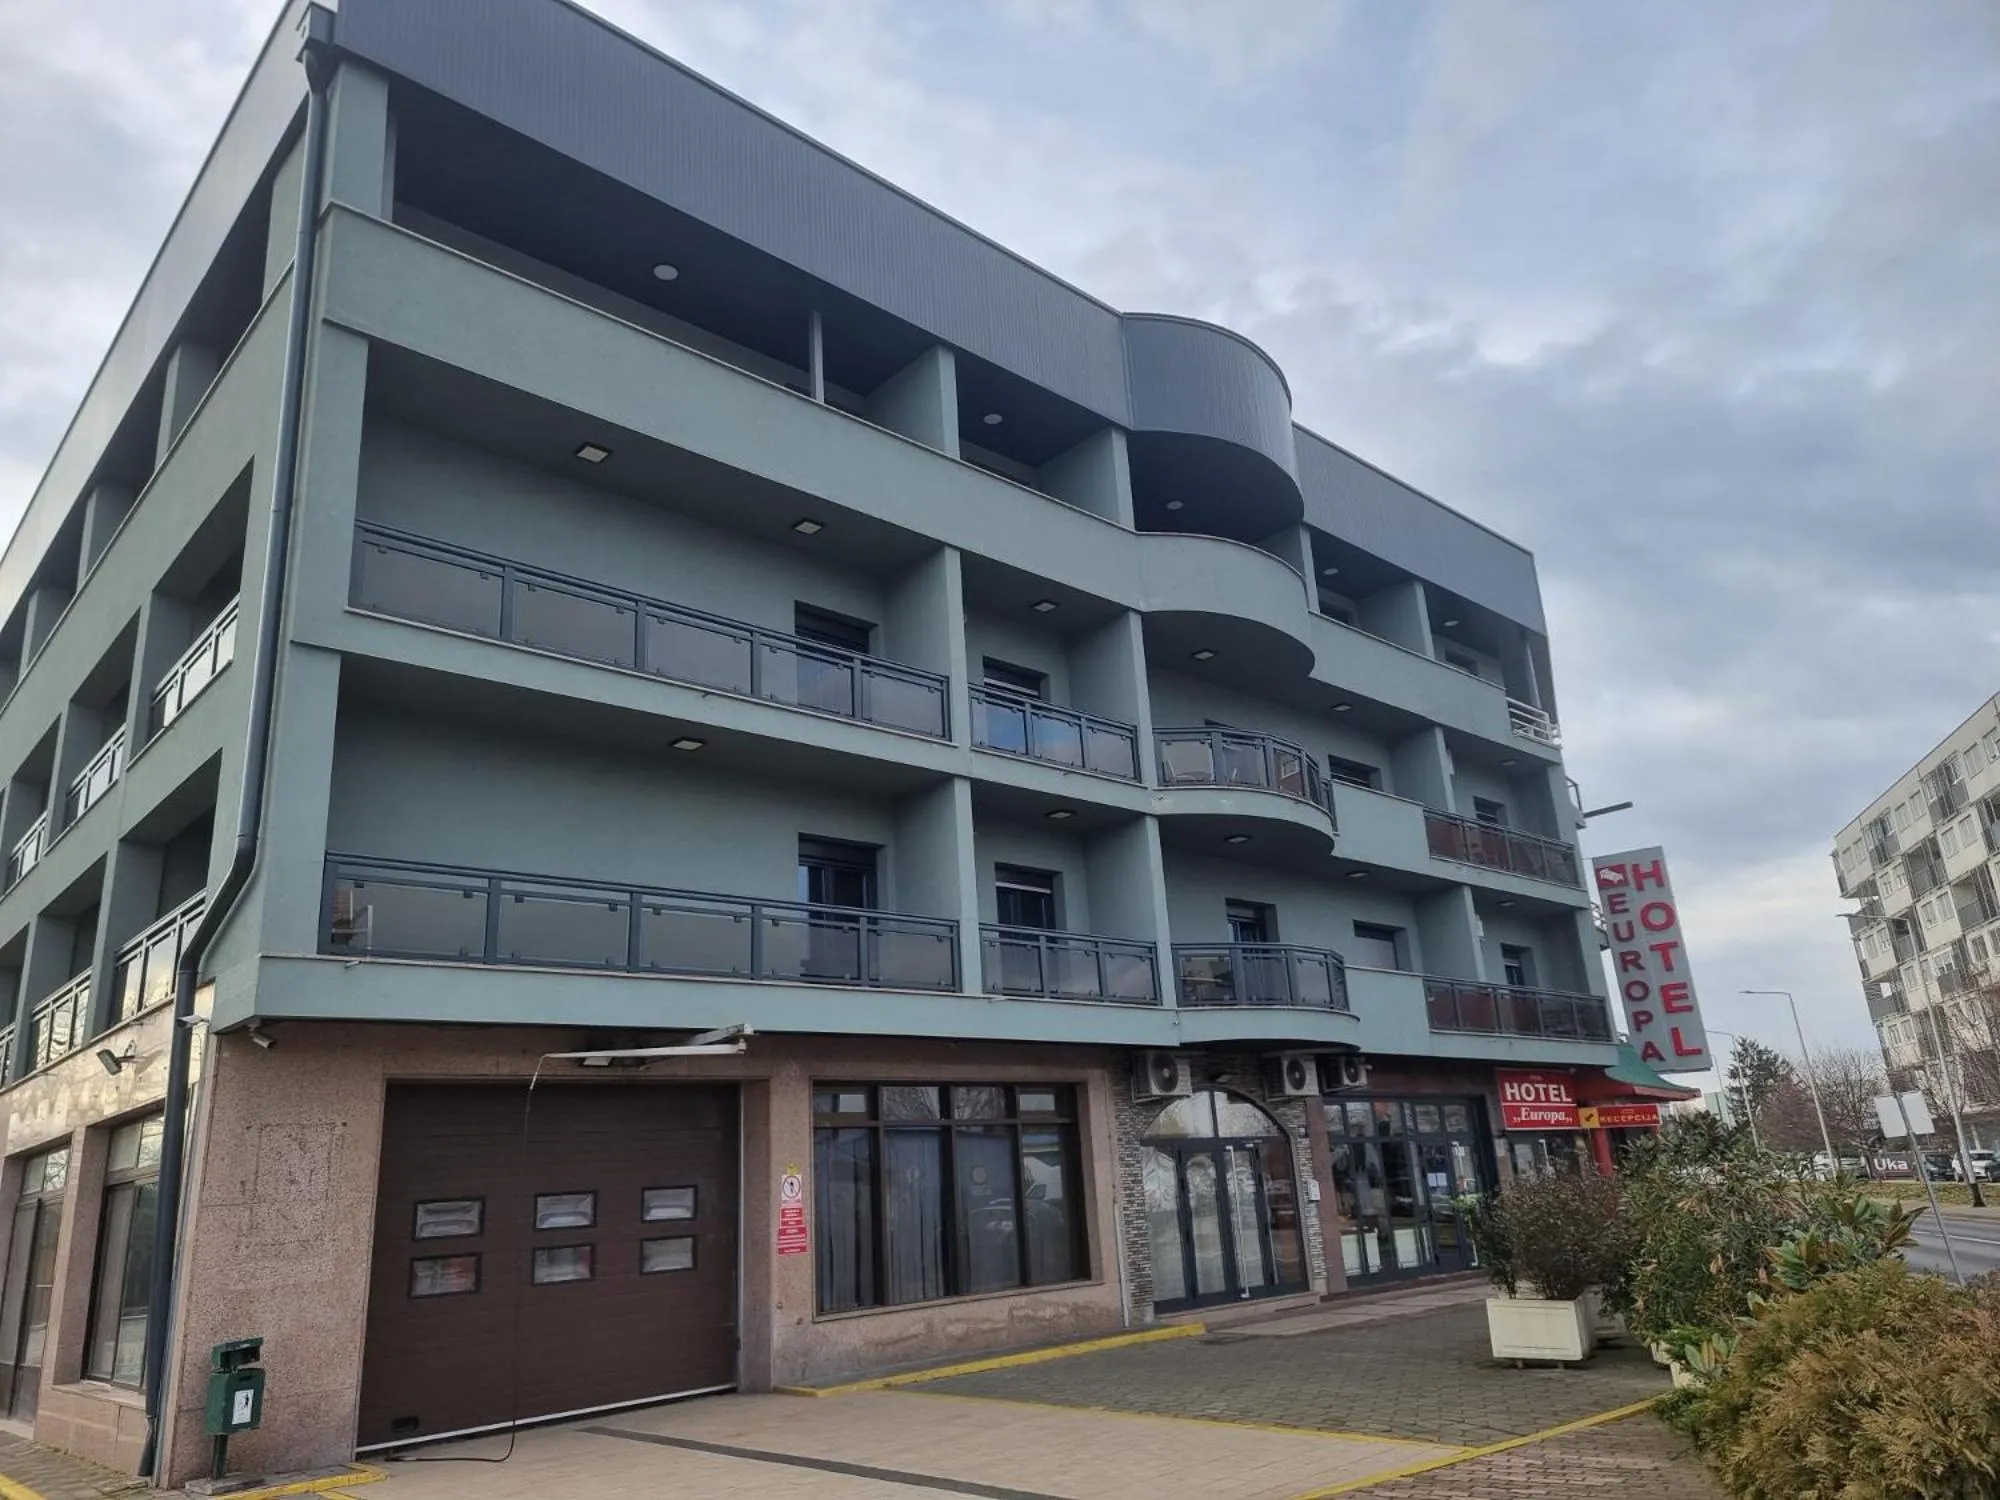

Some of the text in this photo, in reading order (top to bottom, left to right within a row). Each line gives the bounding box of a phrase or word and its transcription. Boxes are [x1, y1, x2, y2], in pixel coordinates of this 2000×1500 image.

[1607, 892, 1666, 1062] EUROPA
[1631, 859, 1704, 1057] HOTEL
[1504, 1082, 1573, 1103] HOTEL
